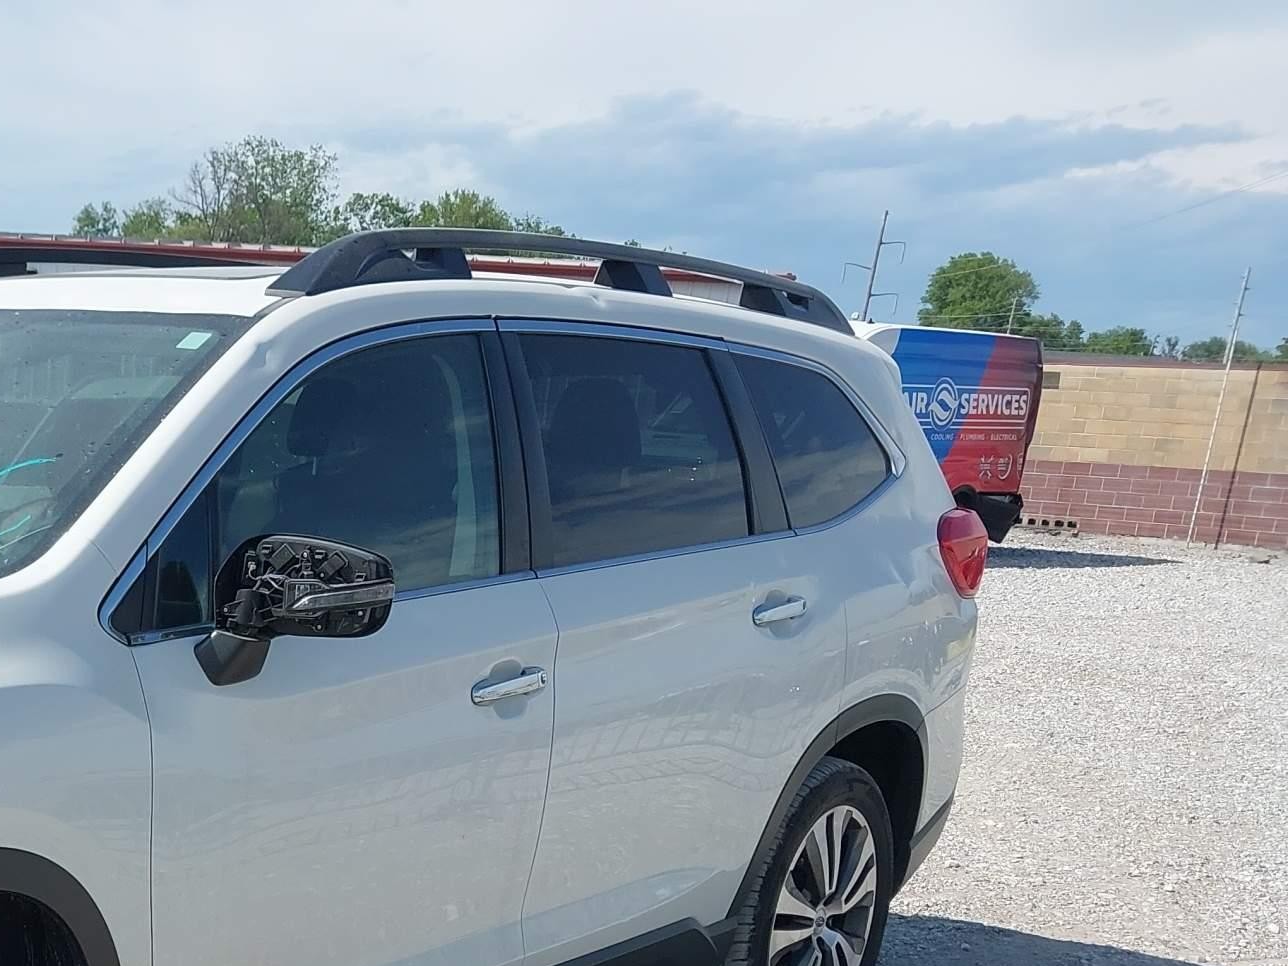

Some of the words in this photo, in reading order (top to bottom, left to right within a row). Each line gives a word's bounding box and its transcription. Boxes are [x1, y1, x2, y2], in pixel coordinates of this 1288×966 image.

[960, 392, 1028, 416] SERVICES
[930, 433, 954, 441] COOLING
[990, 433, 1017, 441] ELECTRICAL
